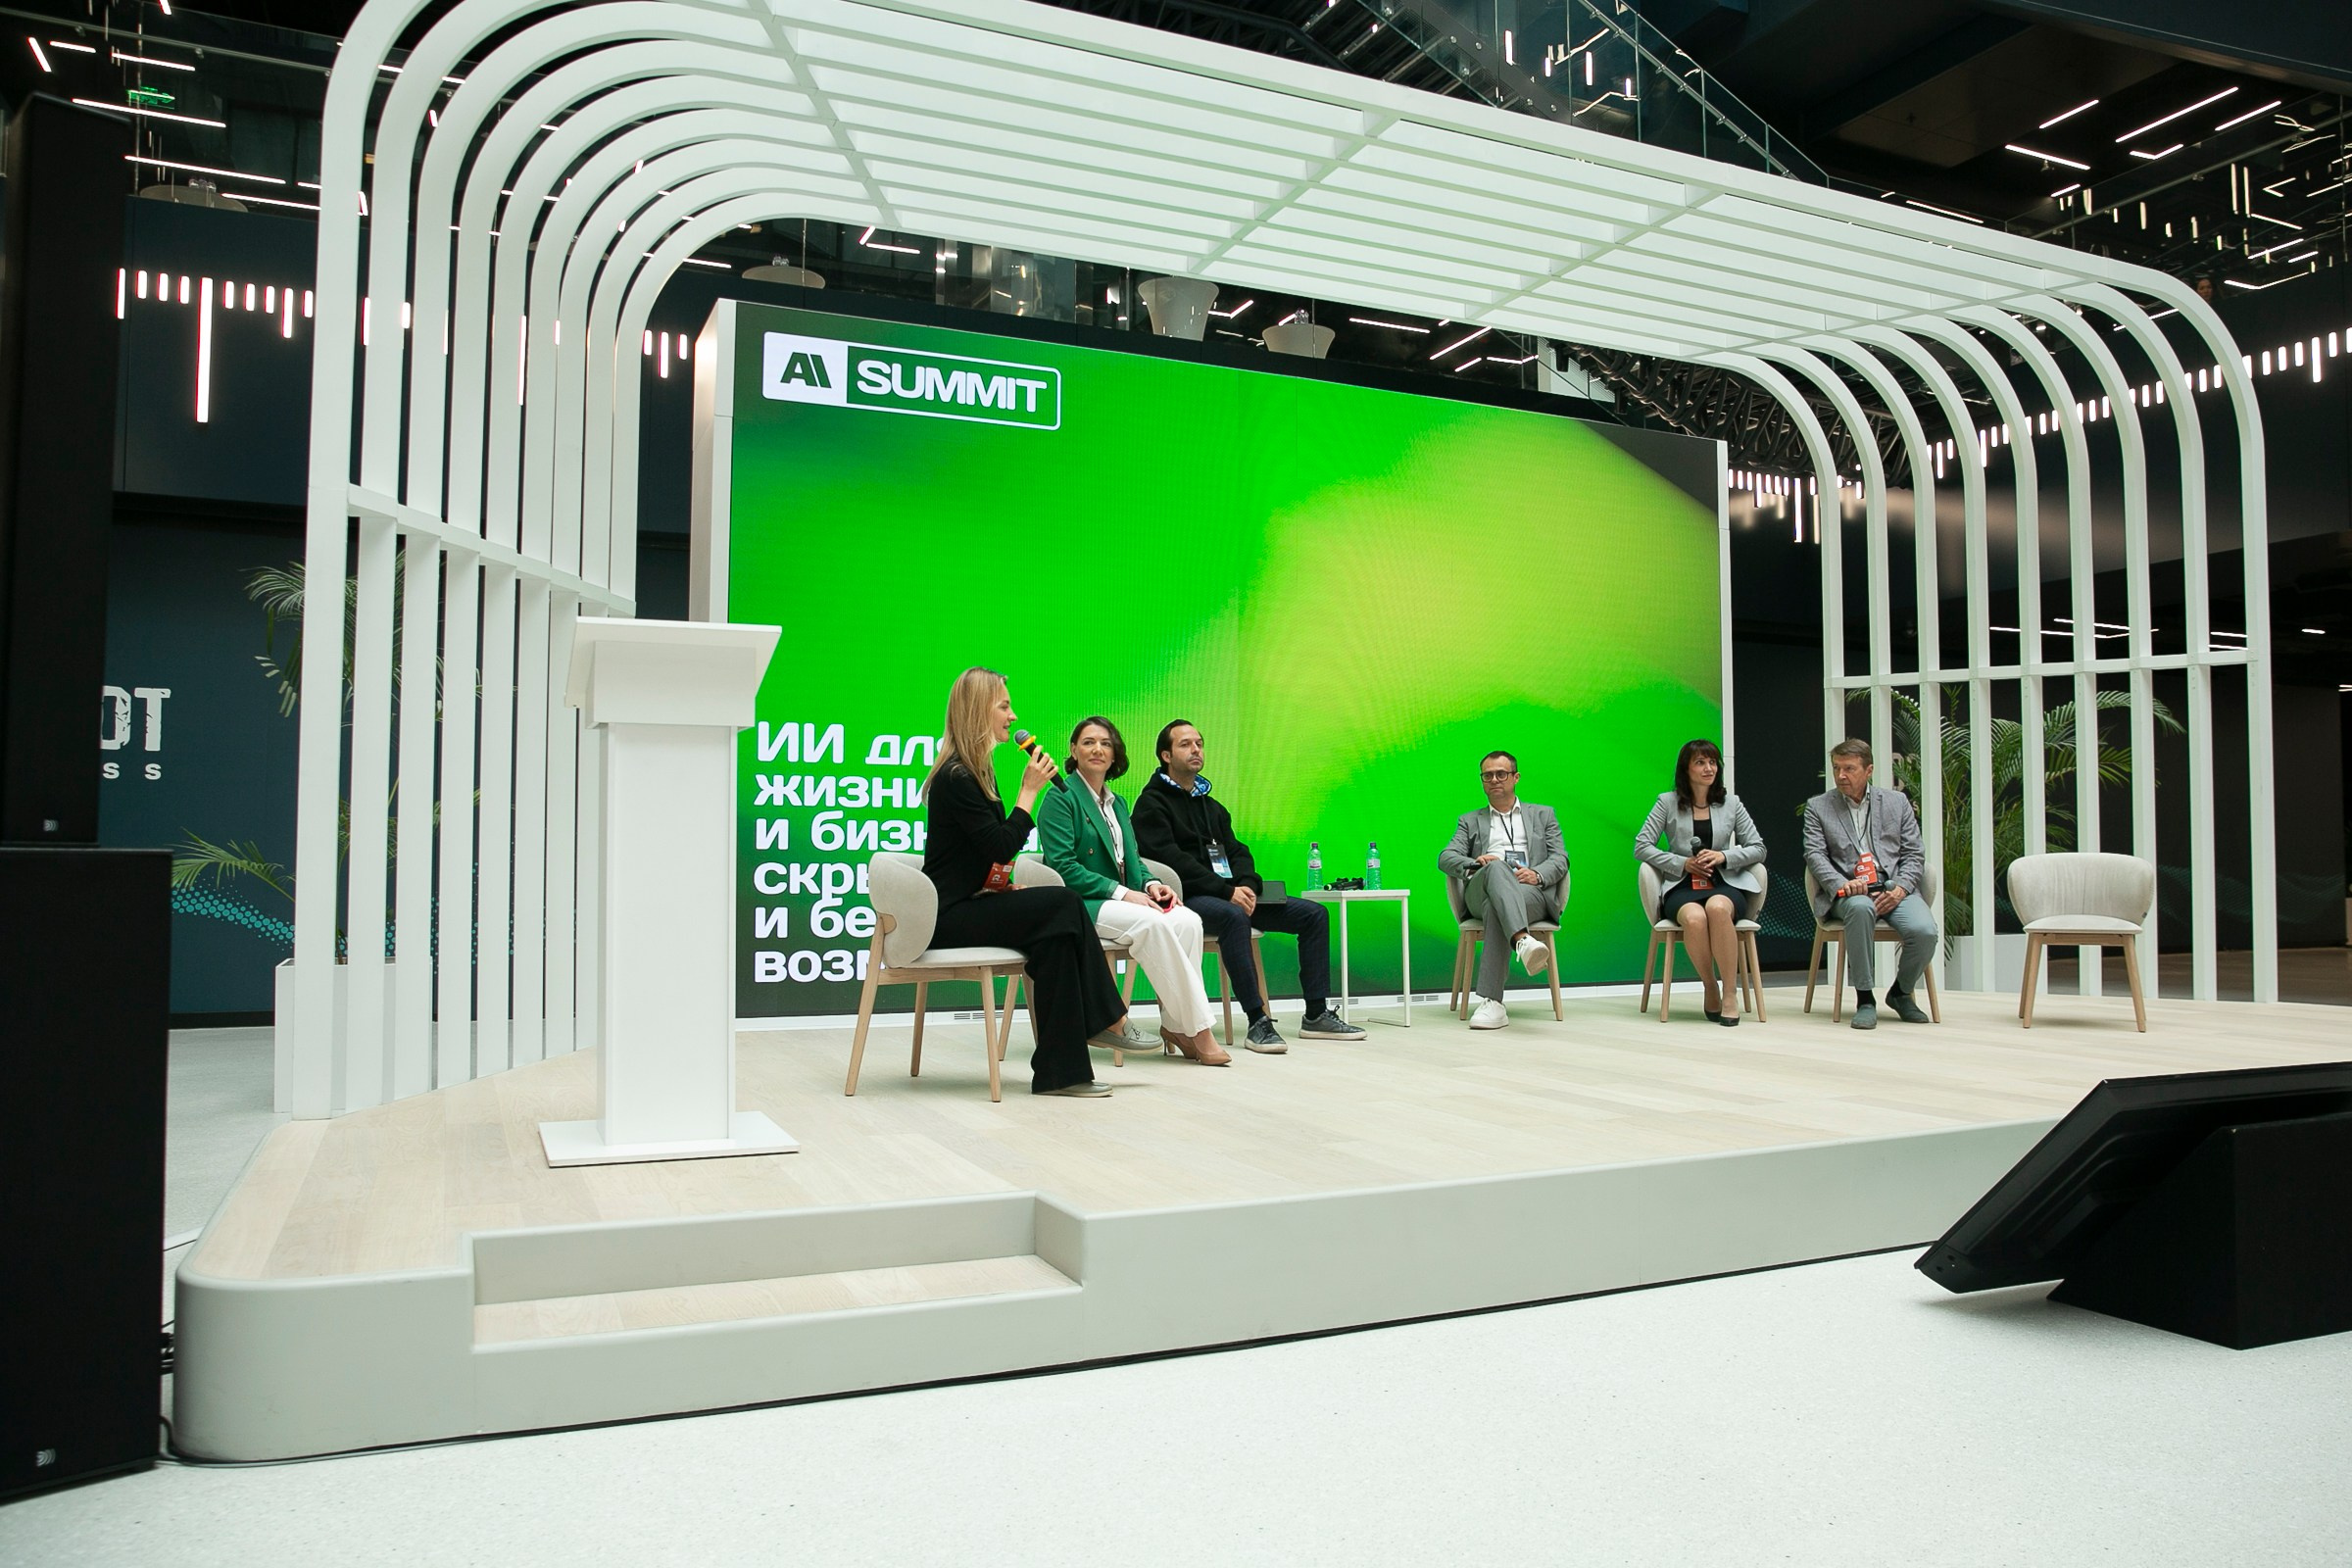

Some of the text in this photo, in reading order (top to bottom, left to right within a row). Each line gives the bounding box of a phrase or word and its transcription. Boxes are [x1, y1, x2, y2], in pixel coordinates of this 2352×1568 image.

[857, 359, 1048, 413] SUMMIT
[758, 720, 945, 766] ИИ дл
